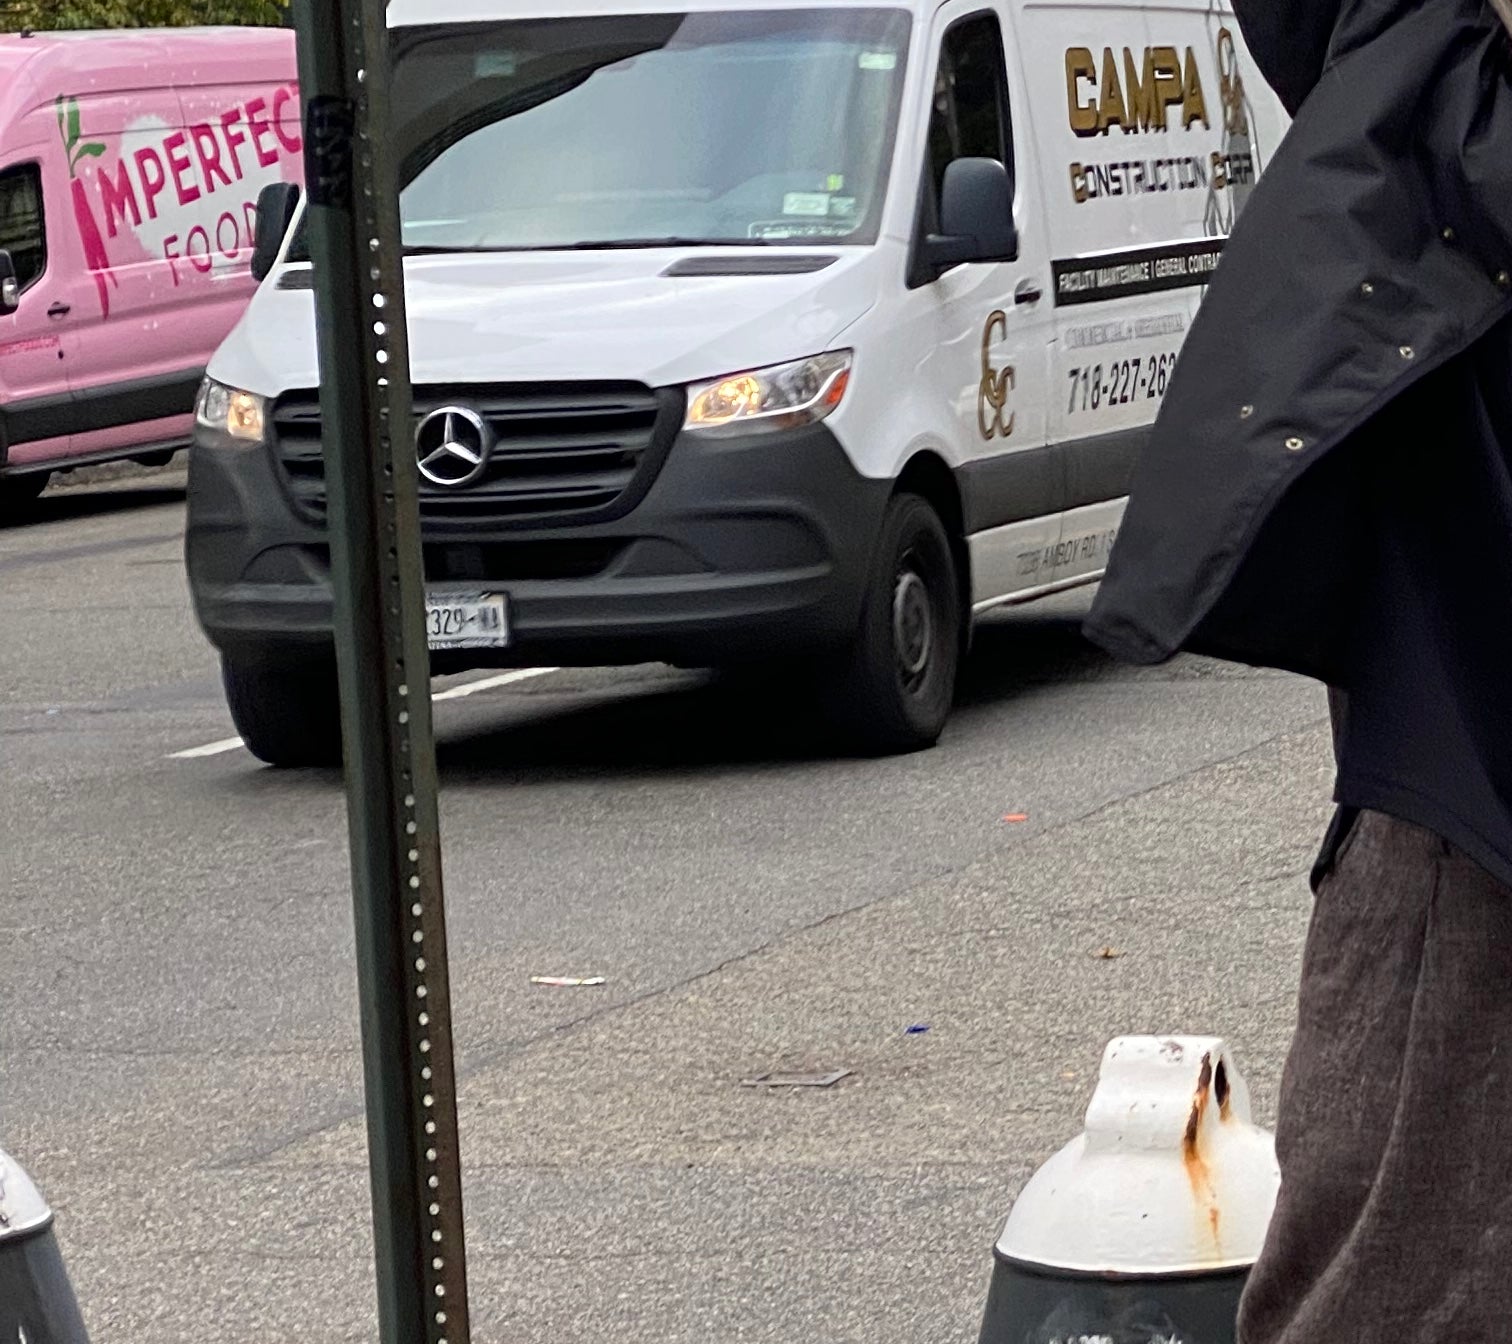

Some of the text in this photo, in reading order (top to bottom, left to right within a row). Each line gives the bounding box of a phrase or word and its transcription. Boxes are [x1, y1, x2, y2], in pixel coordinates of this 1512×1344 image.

[1065, 46, 1210, 137] CAMPA
[70, 80, 303, 319] IMPERFEC
[1070, 157, 1208, 204] CONSTRUCTION
[1155, 257, 1187, 278] GENERAL
